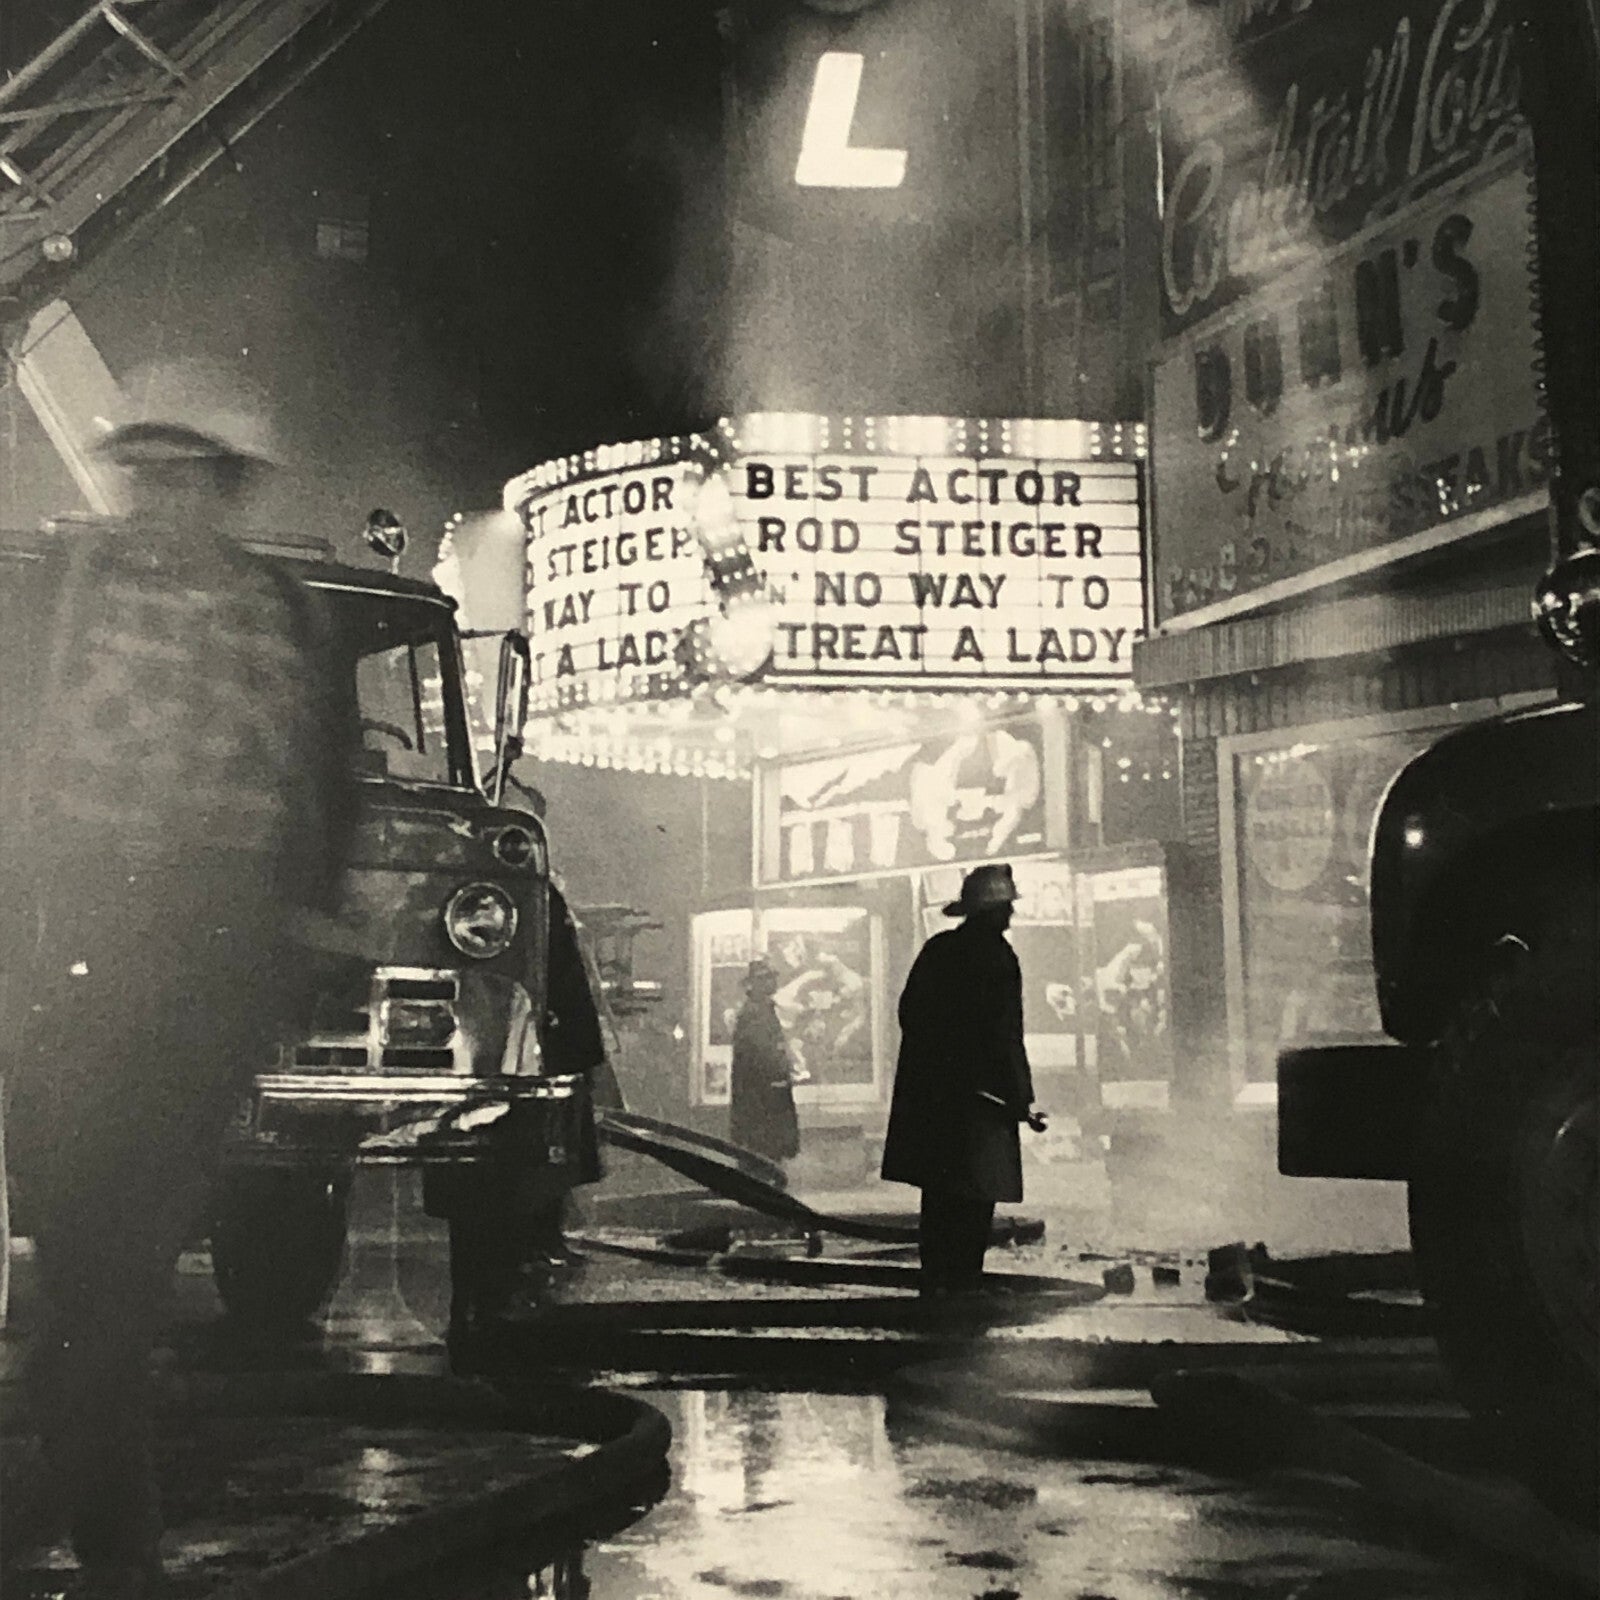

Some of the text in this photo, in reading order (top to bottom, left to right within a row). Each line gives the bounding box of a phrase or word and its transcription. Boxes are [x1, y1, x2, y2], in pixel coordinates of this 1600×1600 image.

[795, 51, 907, 188] L
[562, 476, 674, 528] ACTOR
[746, 462, 1082, 507] BEST ACTOR
[548, 526, 693, 582] STEIGER
[757, 516, 1101, 558] ROD STEIGER
[619, 580, 671, 616] TO
[908, 572, 1006, 609] WAY
[1046, 573, 1109, 610] TO
[557, 643, 576, 679] A
[598, 628, 683, 671] LAD
[777, 622, 928, 661] TREAT
[951, 626, 985, 662] A
